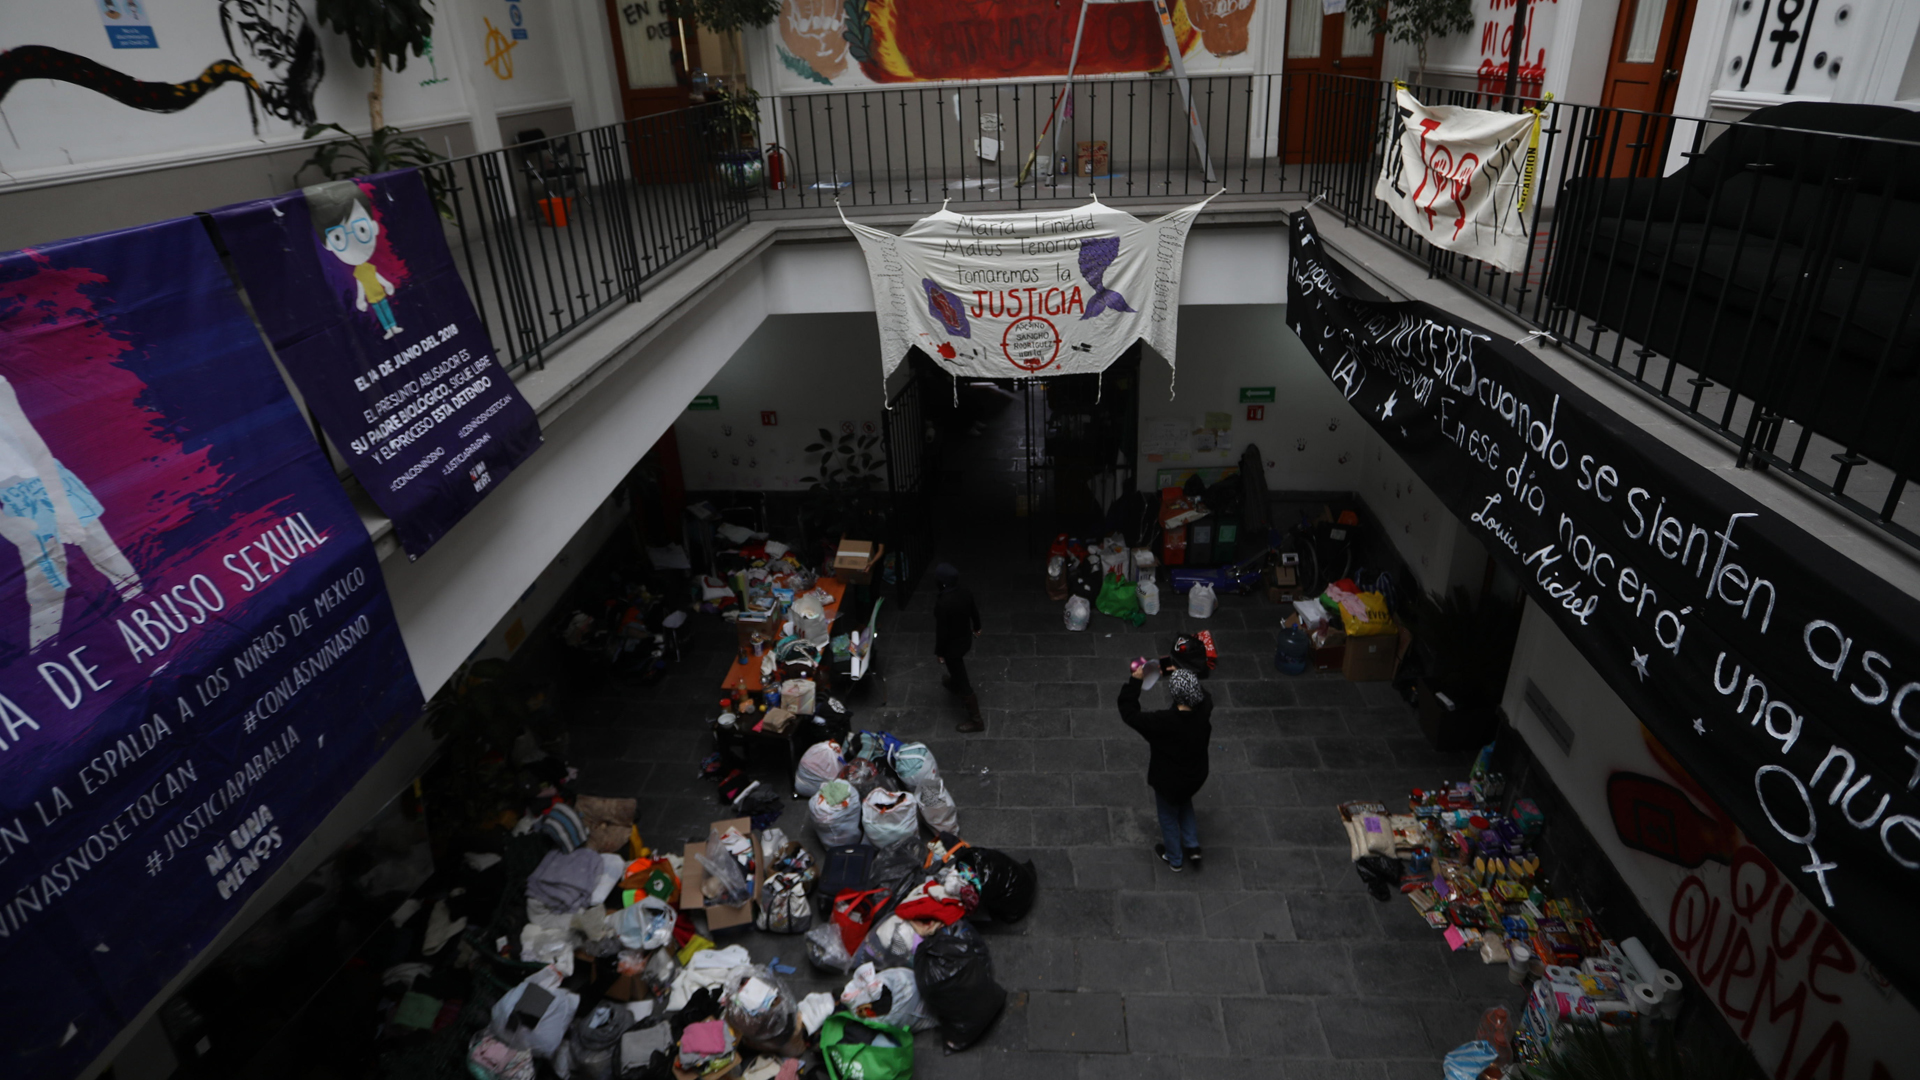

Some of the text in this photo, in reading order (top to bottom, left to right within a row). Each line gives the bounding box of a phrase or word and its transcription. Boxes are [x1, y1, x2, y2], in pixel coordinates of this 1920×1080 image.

[942, 236, 1081, 258] Matus Tenorio
[956, 215, 1016, 236] María
[954, 262, 1071, 284] tomaremos la
[970, 286, 1085, 319] JUSTICIA
[350, 437, 370, 455] SU
[366, 415, 404, 446] PADRE
[449, 367, 475, 389] SIGUE
[471, 354, 493, 376] LIBRE
[354, 375, 371, 392] EL
[377, 360, 396, 377] DE
[394, 343, 422, 370] JUNIO
[420, 334, 441, 353] DEL
[363, 348, 472, 424] EL PRESUNTO ABUSADOR ES
[371, 375, 493, 465] Y EL PROCESO ESTÁ DETENIDO
[1478, 376, 1570, 470] cuando
[1576, 454, 1619, 502] se
[1622, 486, 1777, 634] sienten
[37, 645, 113, 711] DE
[115, 573, 226, 664] ABUSO
[222, 511, 329, 594] SEXUAL
[1521, 543, 1599, 626] Michel
[241, 614, 371, 735] #CONLASNIÑASNO
[1559, 512, 1693, 657] nacerá
[1713, 651, 1803, 754] una
[34, 785, 74, 827] LA
[78, 713, 172, 795] ESPALDA
[177, 695, 195, 724] A
[195, 666, 231, 707] LOS
[233, 624, 288, 679] NIÑOS
[288, 606, 313, 638] DE
[313, 566, 366, 620] MEXICO
[144, 725, 301, 877] #JUSTICIAPARALIA
[230, 804, 275, 850] UNA
